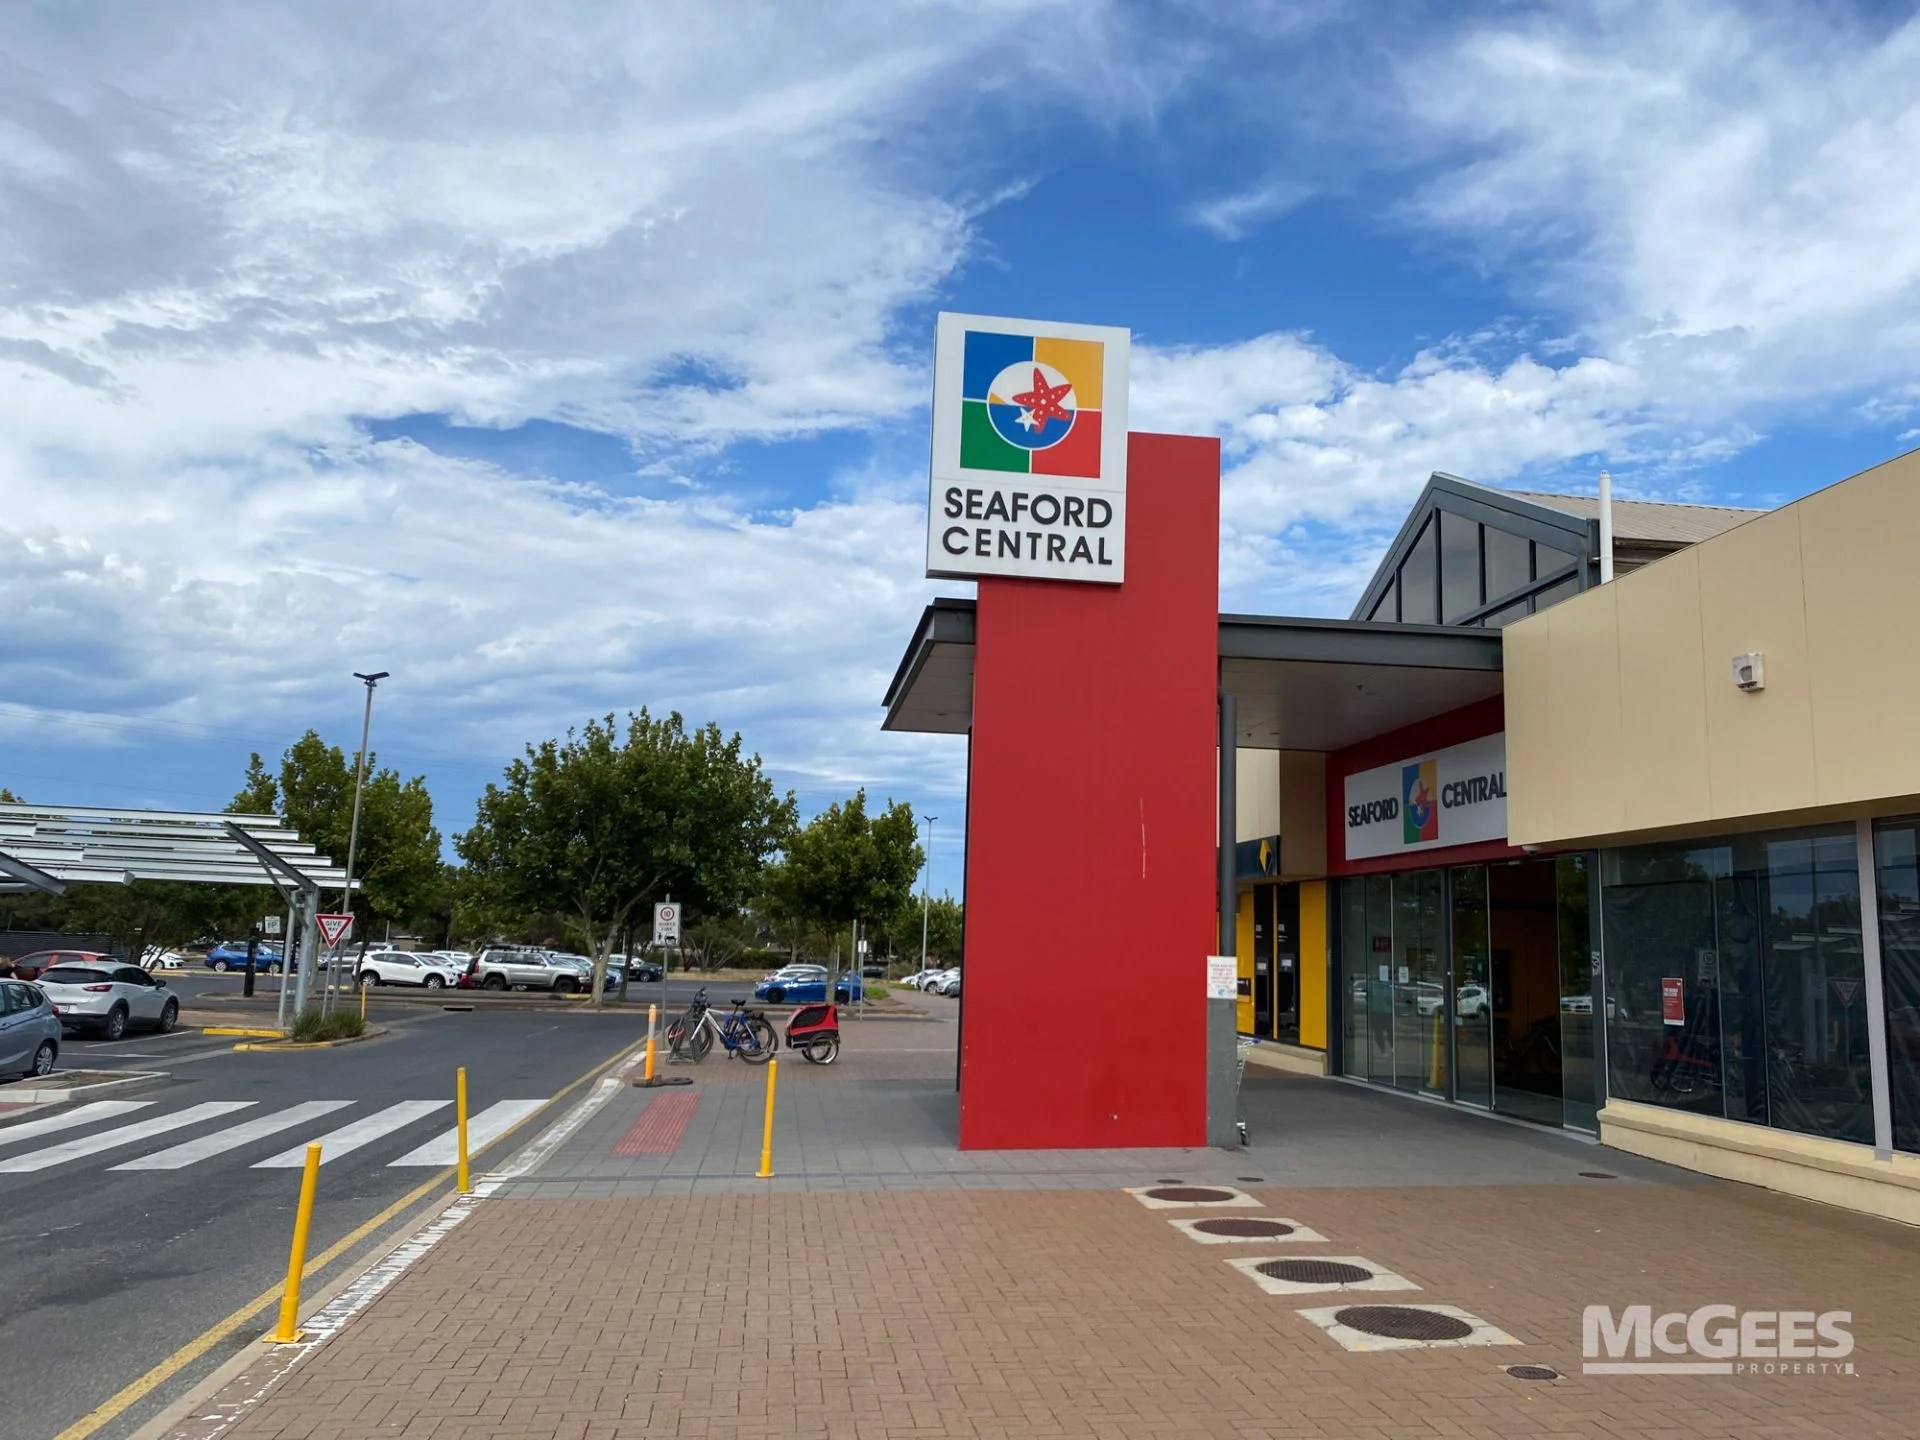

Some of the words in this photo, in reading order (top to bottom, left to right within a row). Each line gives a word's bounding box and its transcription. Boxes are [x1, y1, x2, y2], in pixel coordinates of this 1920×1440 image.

[944, 487, 1113, 528] SEAFORD
[942, 526, 1113, 565] CENTRAL
[1348, 797, 1399, 828] SEAFORD
[1441, 772, 1507, 809] CENTRAL
